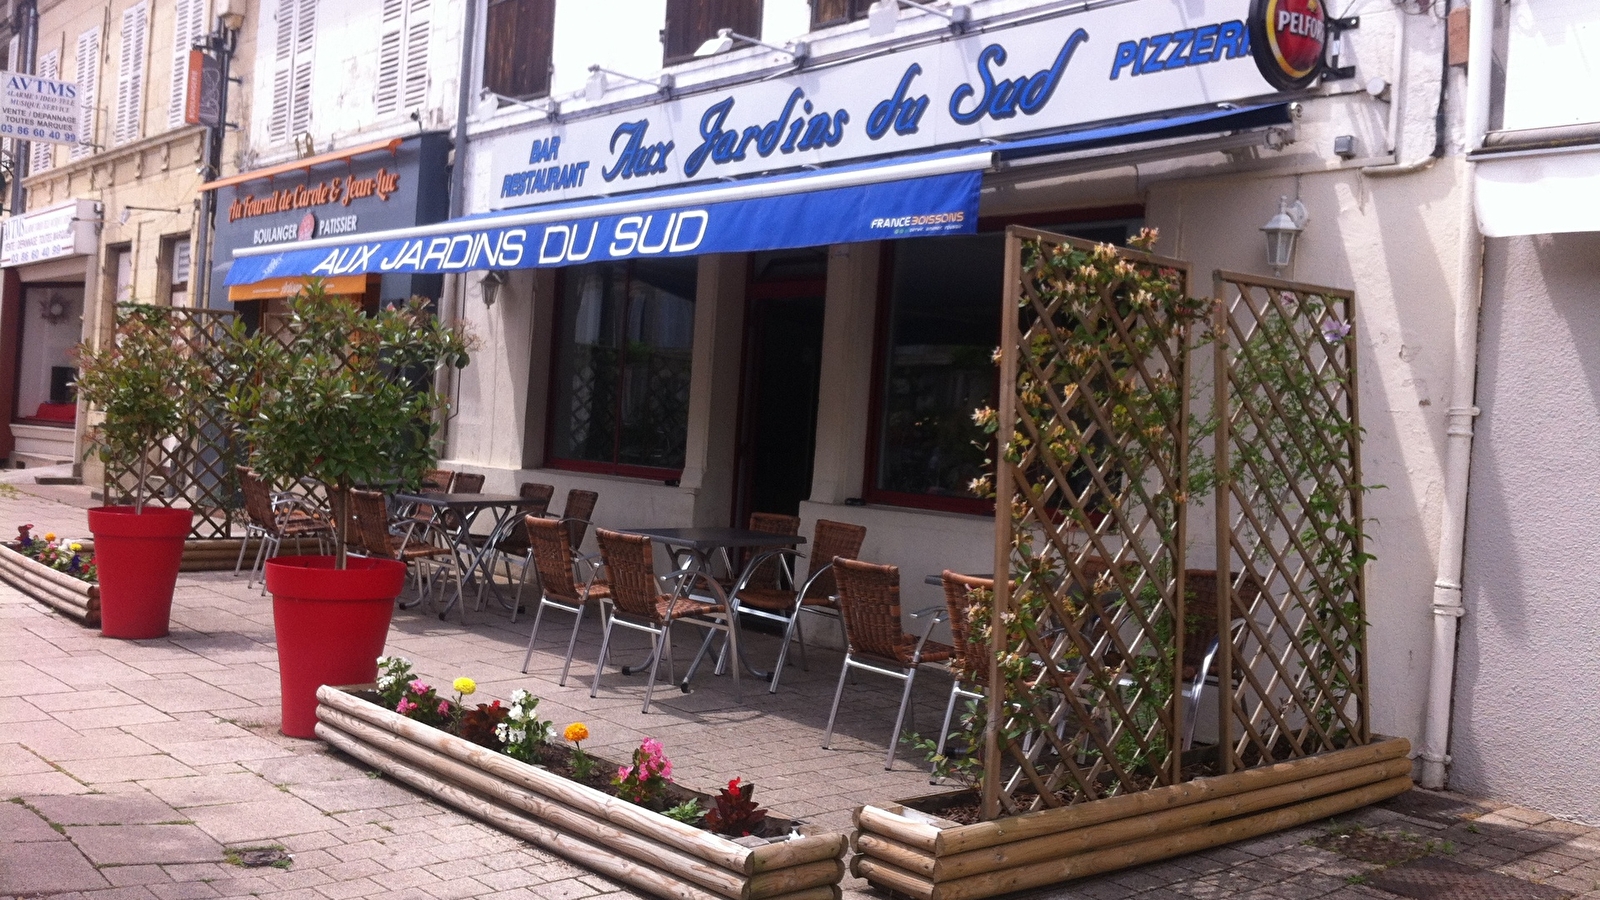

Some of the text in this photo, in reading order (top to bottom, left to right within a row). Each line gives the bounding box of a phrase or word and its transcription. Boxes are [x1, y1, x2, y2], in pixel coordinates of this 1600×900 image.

[1110, 18, 1252, 80] PIZZERI
[6, 76, 76, 98] AVTMS
[10, 98, 40, 109] MUSIQUE
[601, 27, 1089, 183] Aux Jardins du Sud
[2, 107, 26, 116] VENTE
[32, 111, 77, 124] DEPANNAGE
[5, 115, 73, 131] TOUTES MARQUES
[1, 123, 76, 142] 03 86 60 40 99
[529, 135, 561, 165] BAR
[500, 161, 590, 198] RESTAURANT
[228, 198, 242, 223] Au
[242, 190, 278, 218] Fournil
[279, 192, 292, 210] de
[293, 182, 327, 209] Carole
[342, 168, 399, 207] Jean-Luc
[253, 223, 298, 244] BOULANGER
[319, 214, 358, 235] PATISSIER
[311, 243, 381, 274] AUX
[381, 229, 525, 273] JARDINS
[538, 219, 599, 265] DU
[609, 210, 708, 256] SUD
